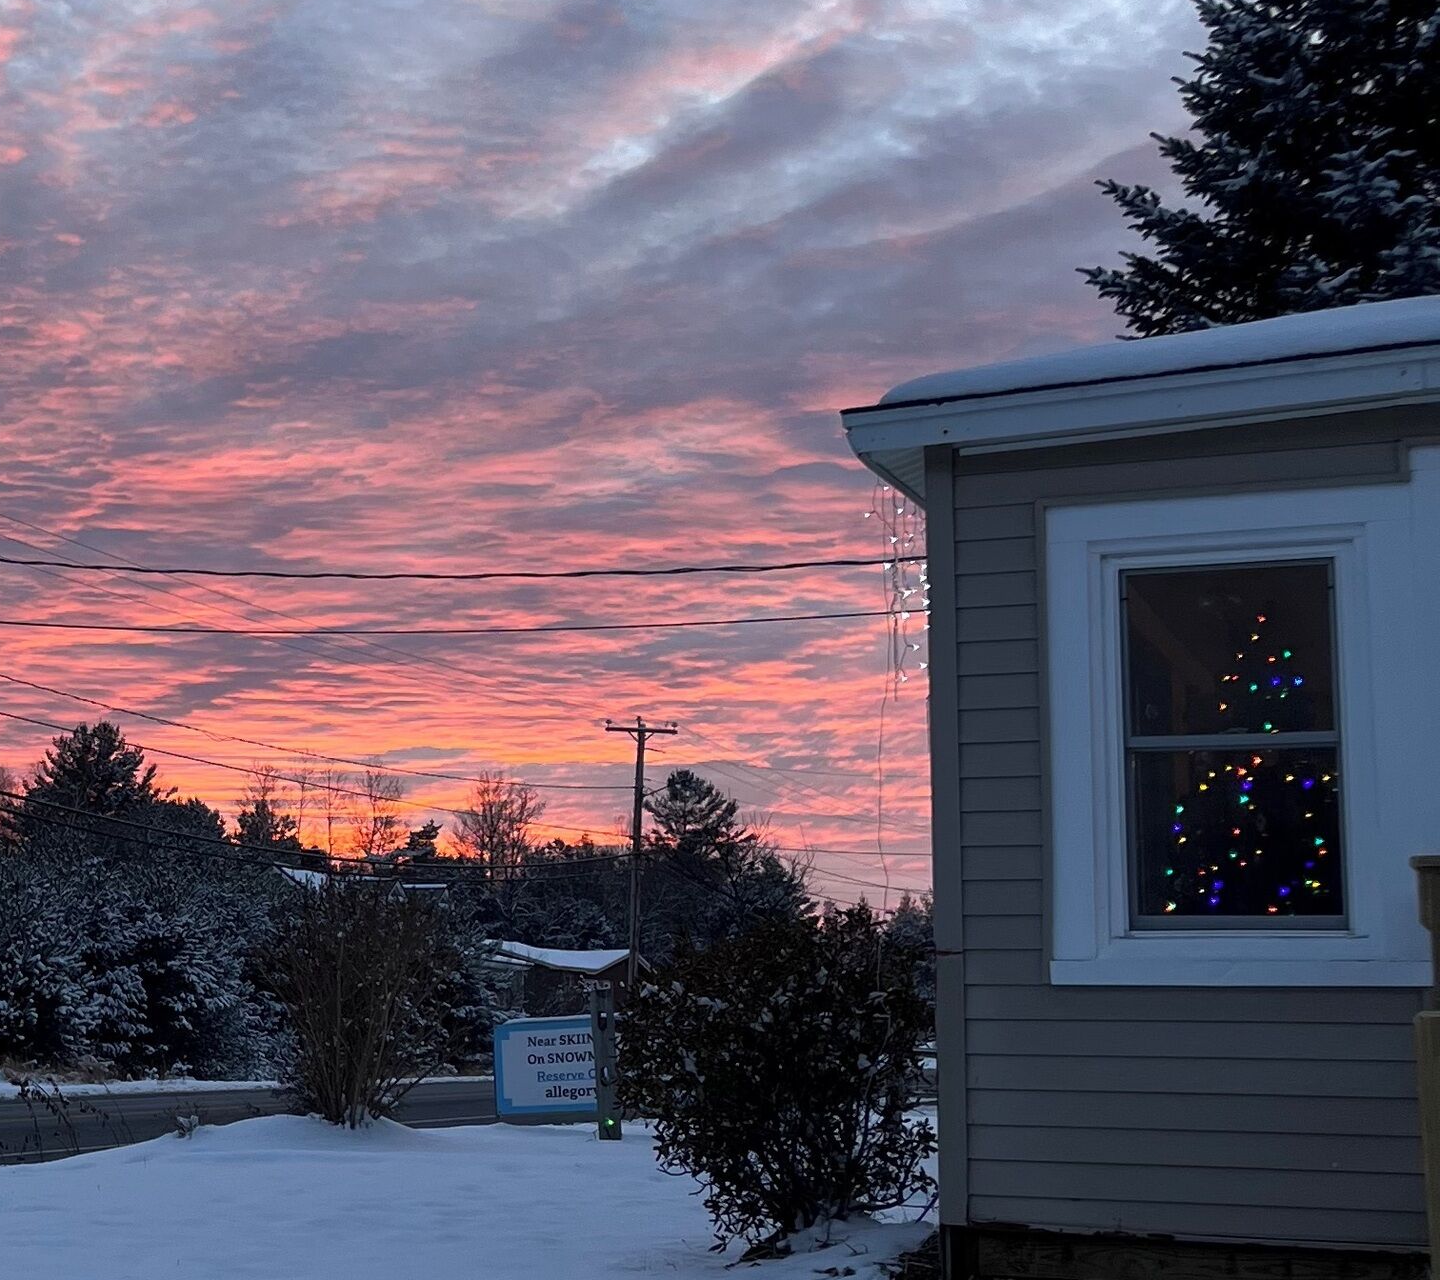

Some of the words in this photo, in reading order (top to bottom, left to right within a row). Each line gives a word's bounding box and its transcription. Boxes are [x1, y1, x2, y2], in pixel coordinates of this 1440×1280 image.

[527, 1036, 556, 1047] Near
[527, 1053, 545, 1065] On
[537, 1071, 584, 1082] Reserve
